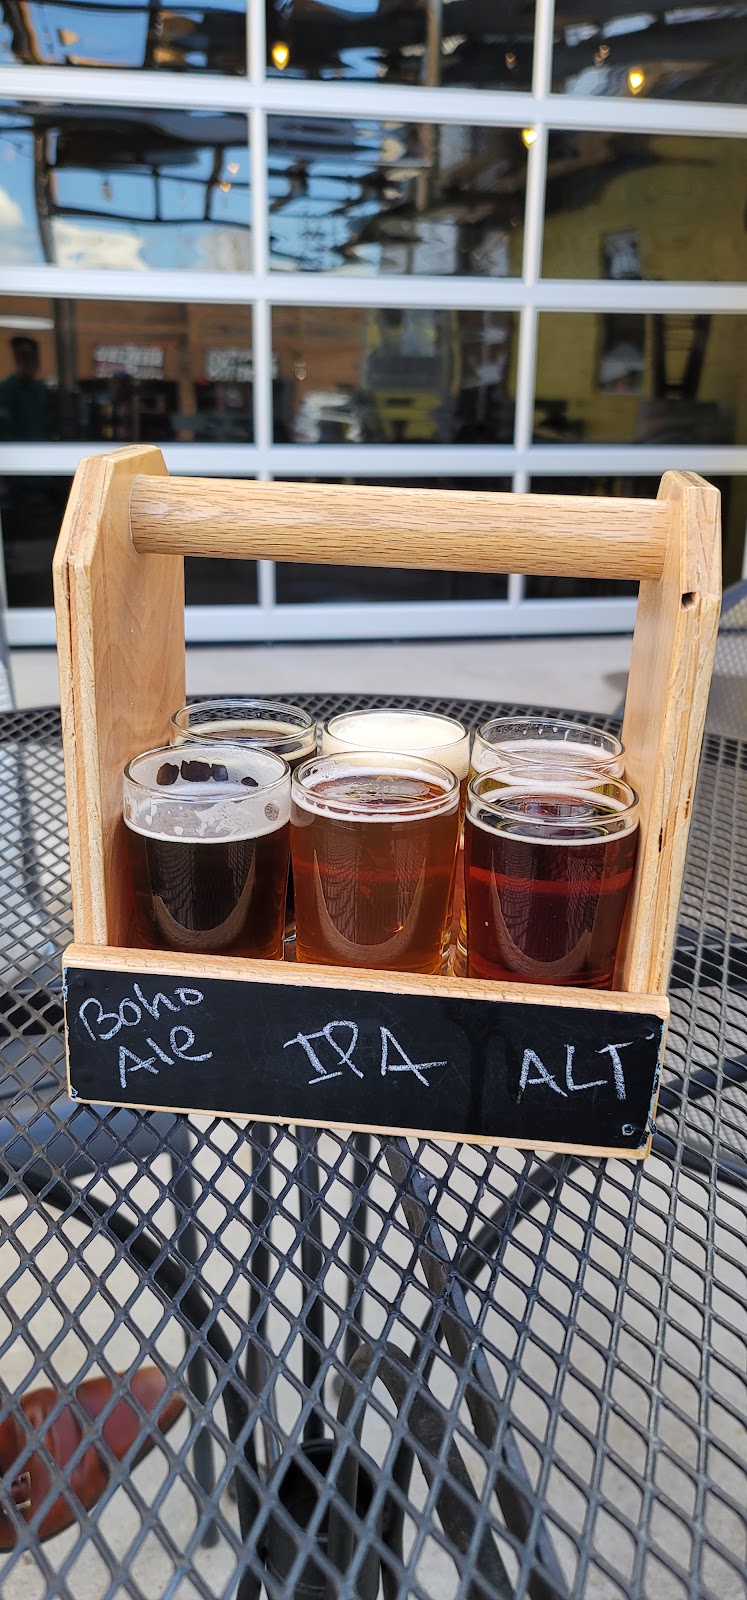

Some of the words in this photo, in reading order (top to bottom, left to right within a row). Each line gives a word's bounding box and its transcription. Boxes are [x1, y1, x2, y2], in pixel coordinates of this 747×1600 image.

[78, 982, 205, 1041] Boho
[118, 1025, 213, 1089] Ale
[283, 1020, 448, 1087] IPA
[517, 1041, 634, 1104] ALT
